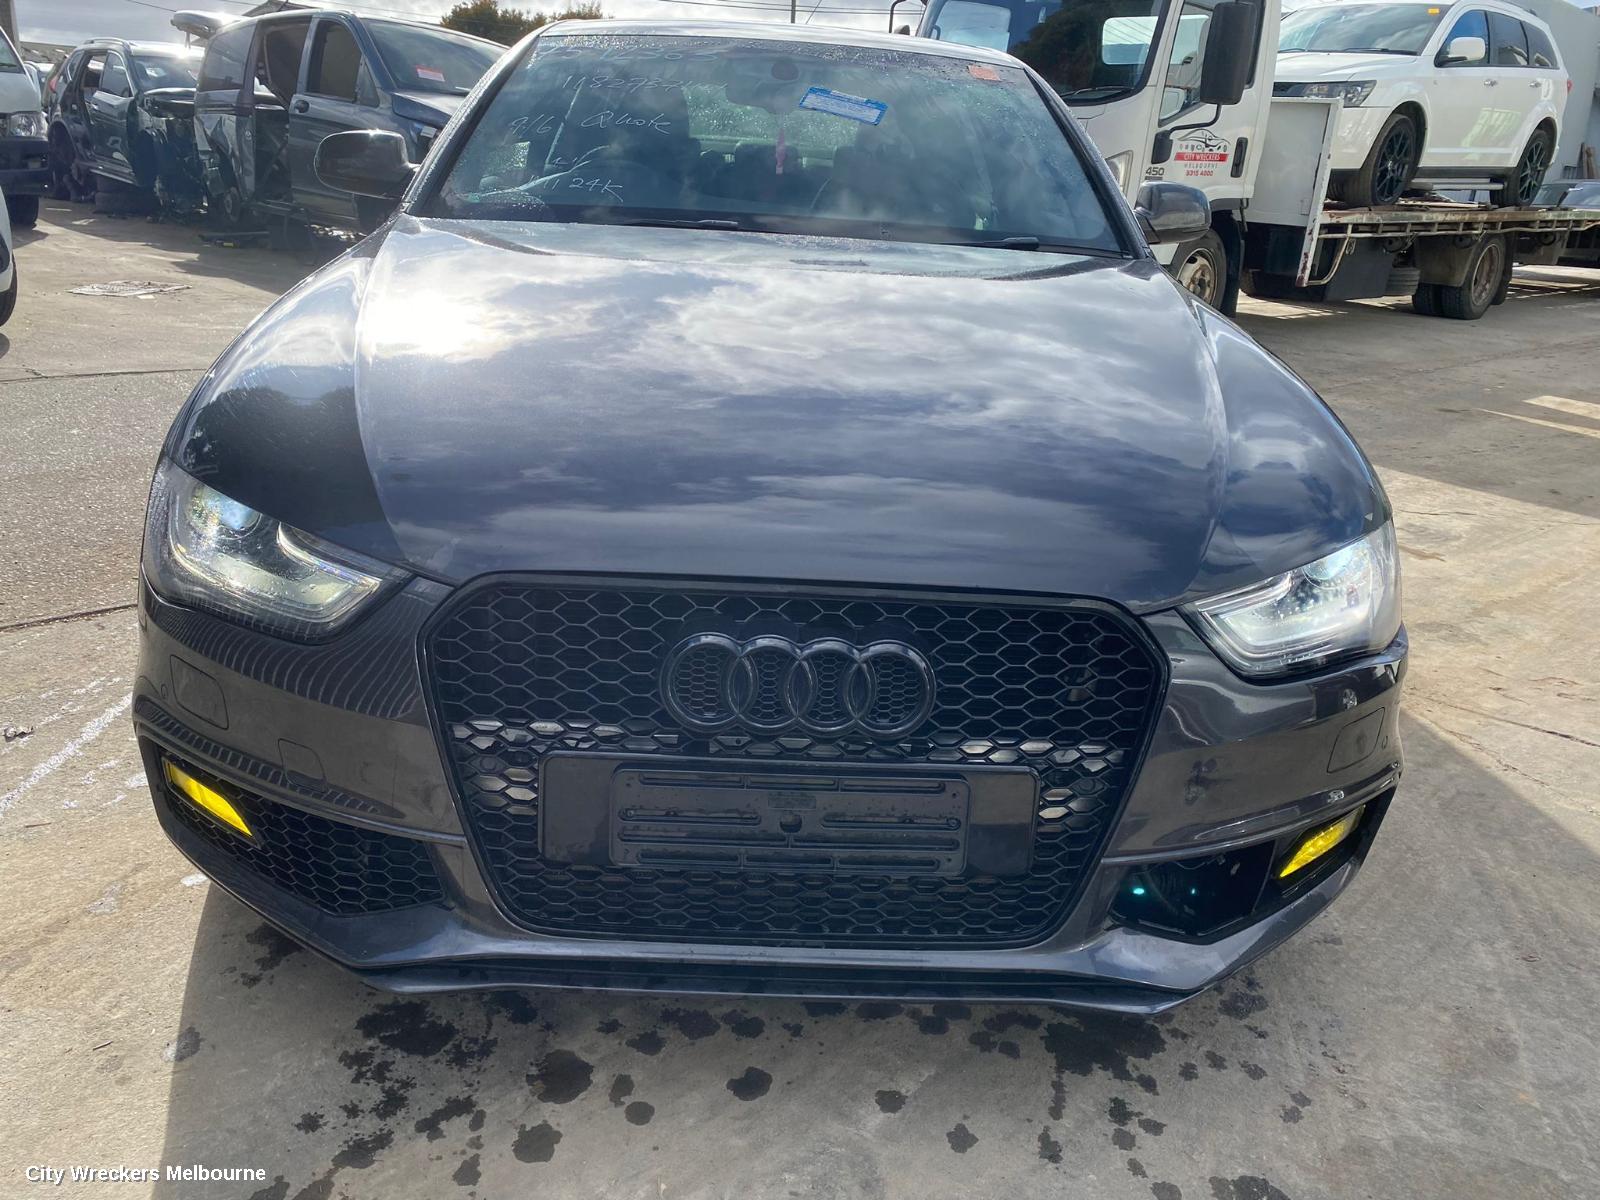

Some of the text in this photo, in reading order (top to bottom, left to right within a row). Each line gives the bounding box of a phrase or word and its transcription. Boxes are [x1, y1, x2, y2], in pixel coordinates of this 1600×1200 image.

[1184, 153, 1221, 161] CITY WRECKERS
[1145, 166, 1165, 176] 450
[1200, 169, 1213, 177] 4000
